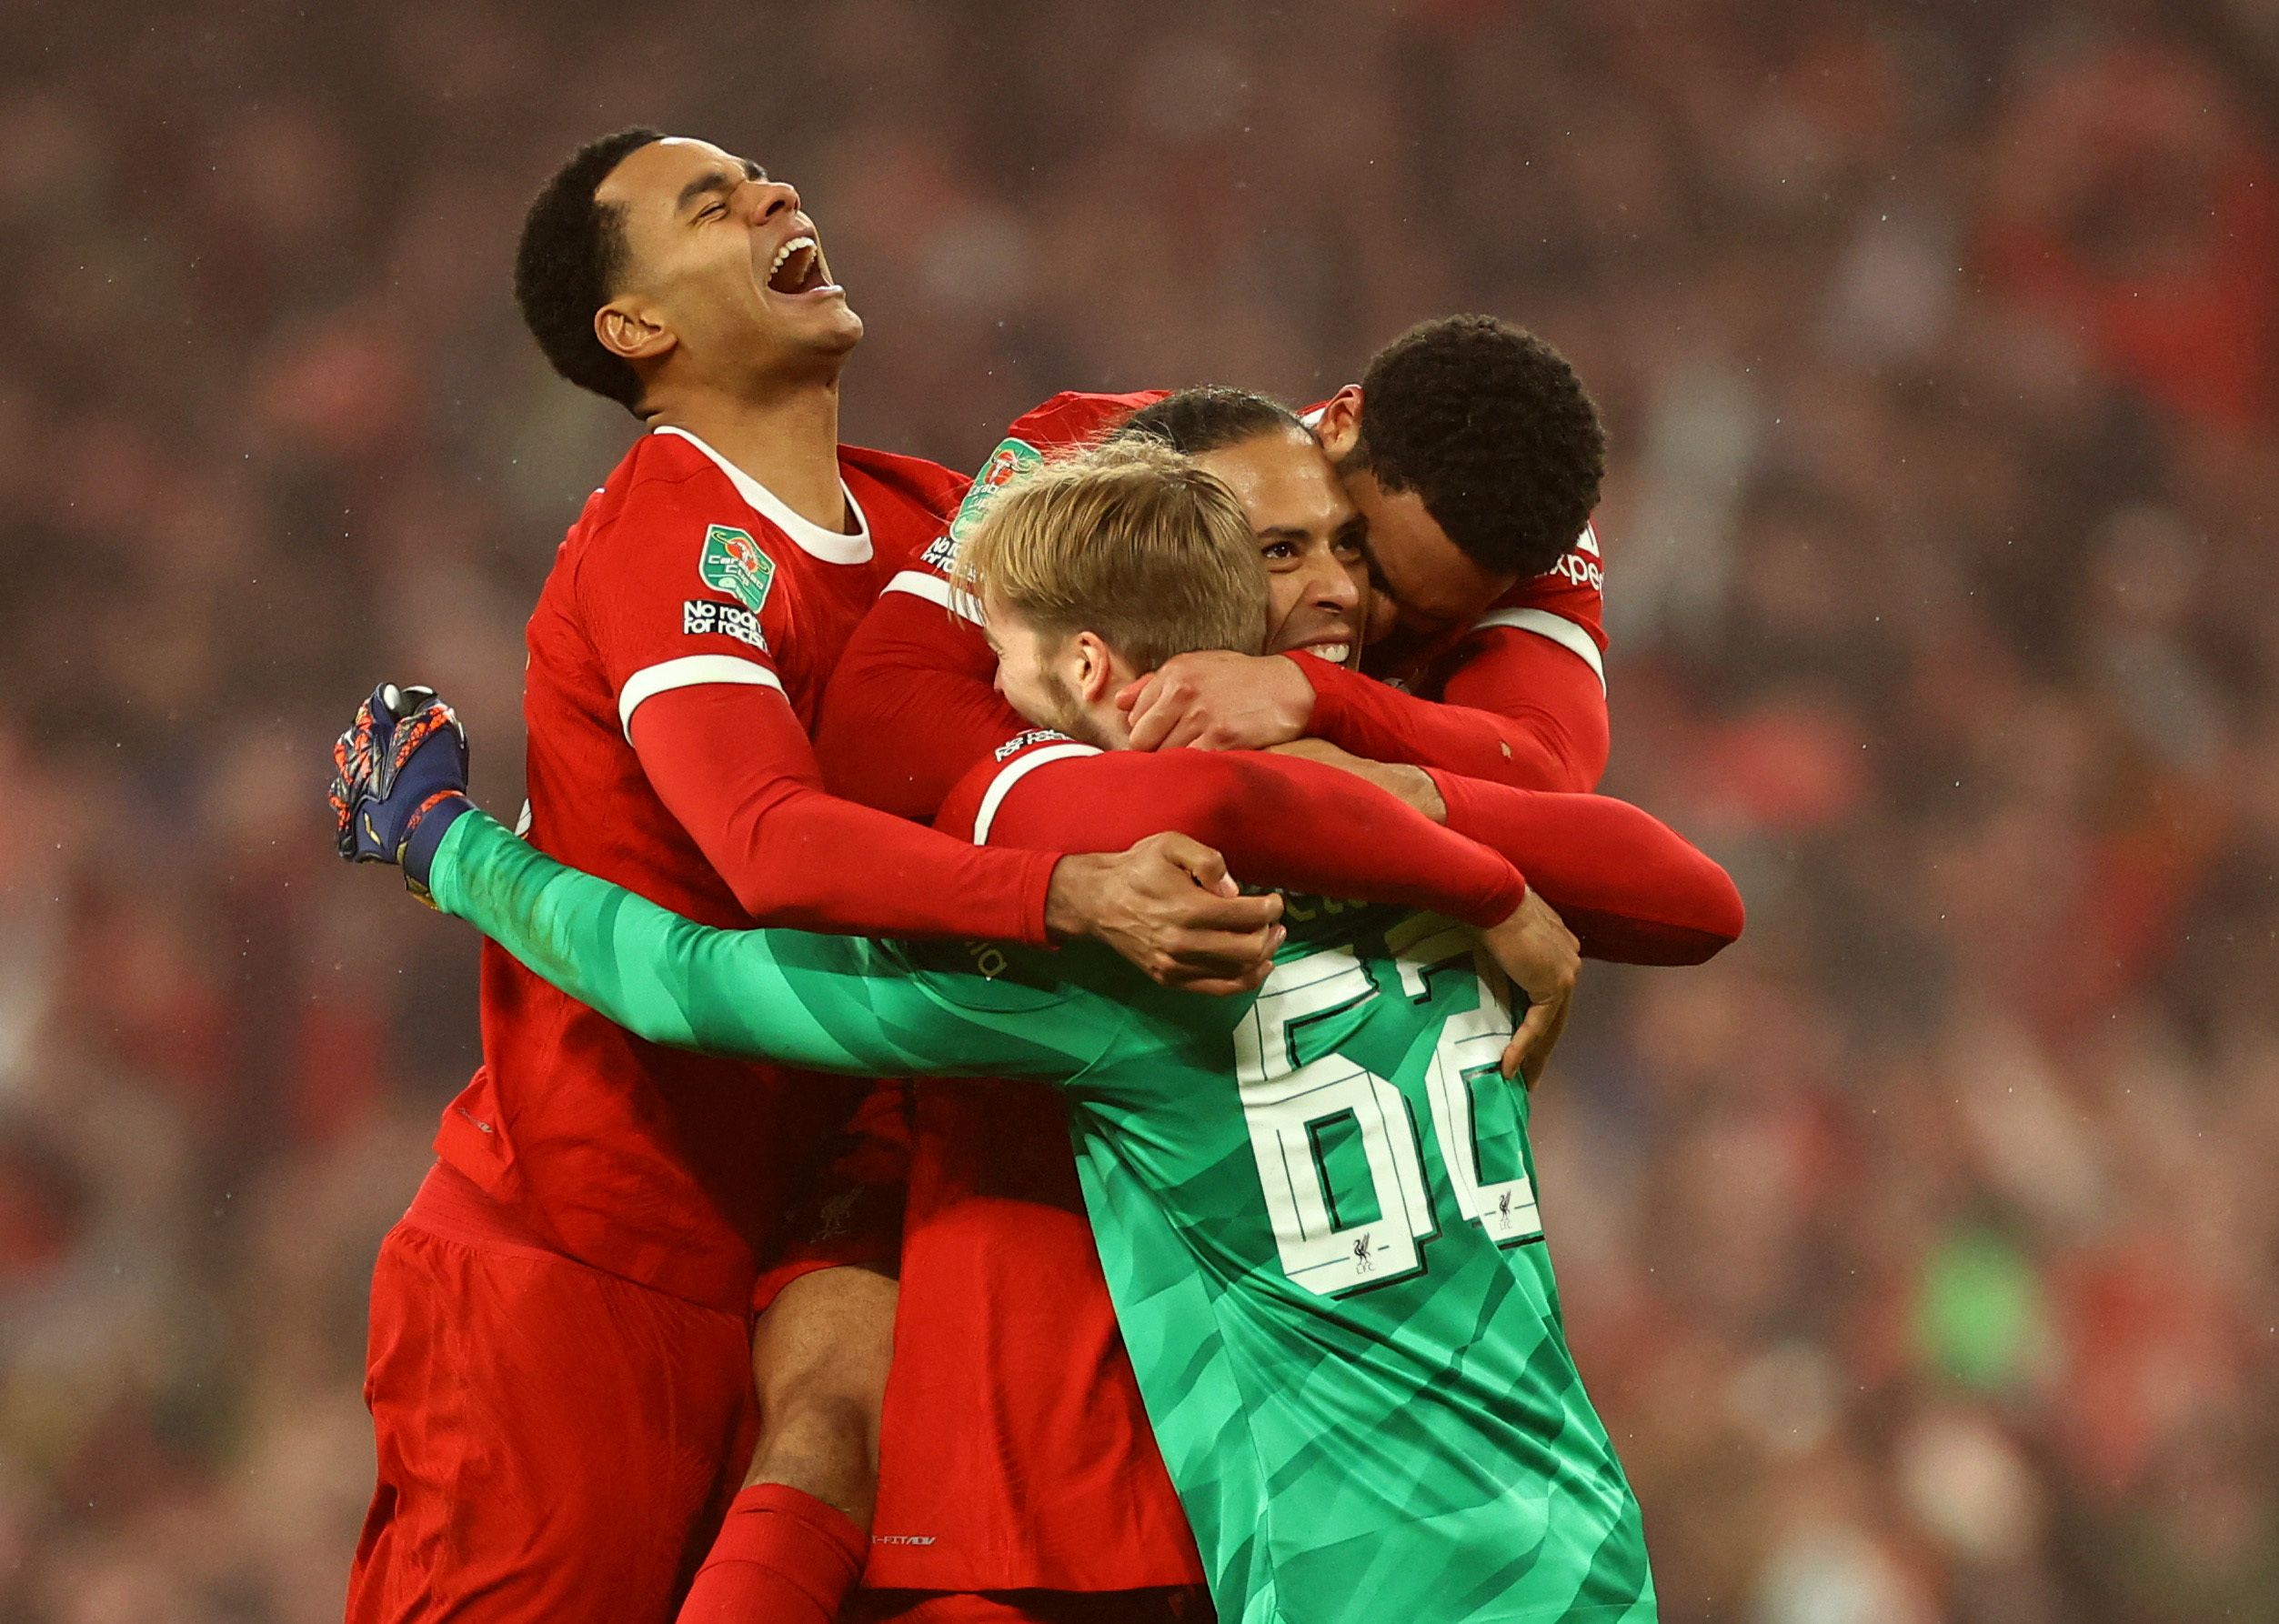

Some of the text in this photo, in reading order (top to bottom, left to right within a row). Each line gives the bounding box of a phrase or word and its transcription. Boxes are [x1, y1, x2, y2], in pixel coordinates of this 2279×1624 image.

[708, 555, 764, 590] Carabao
[725, 564, 749, 586] Cup
[684, 600, 717, 617] No
[684, 617, 716, 635] for
[1232, 909, 1544, 1296] 62
